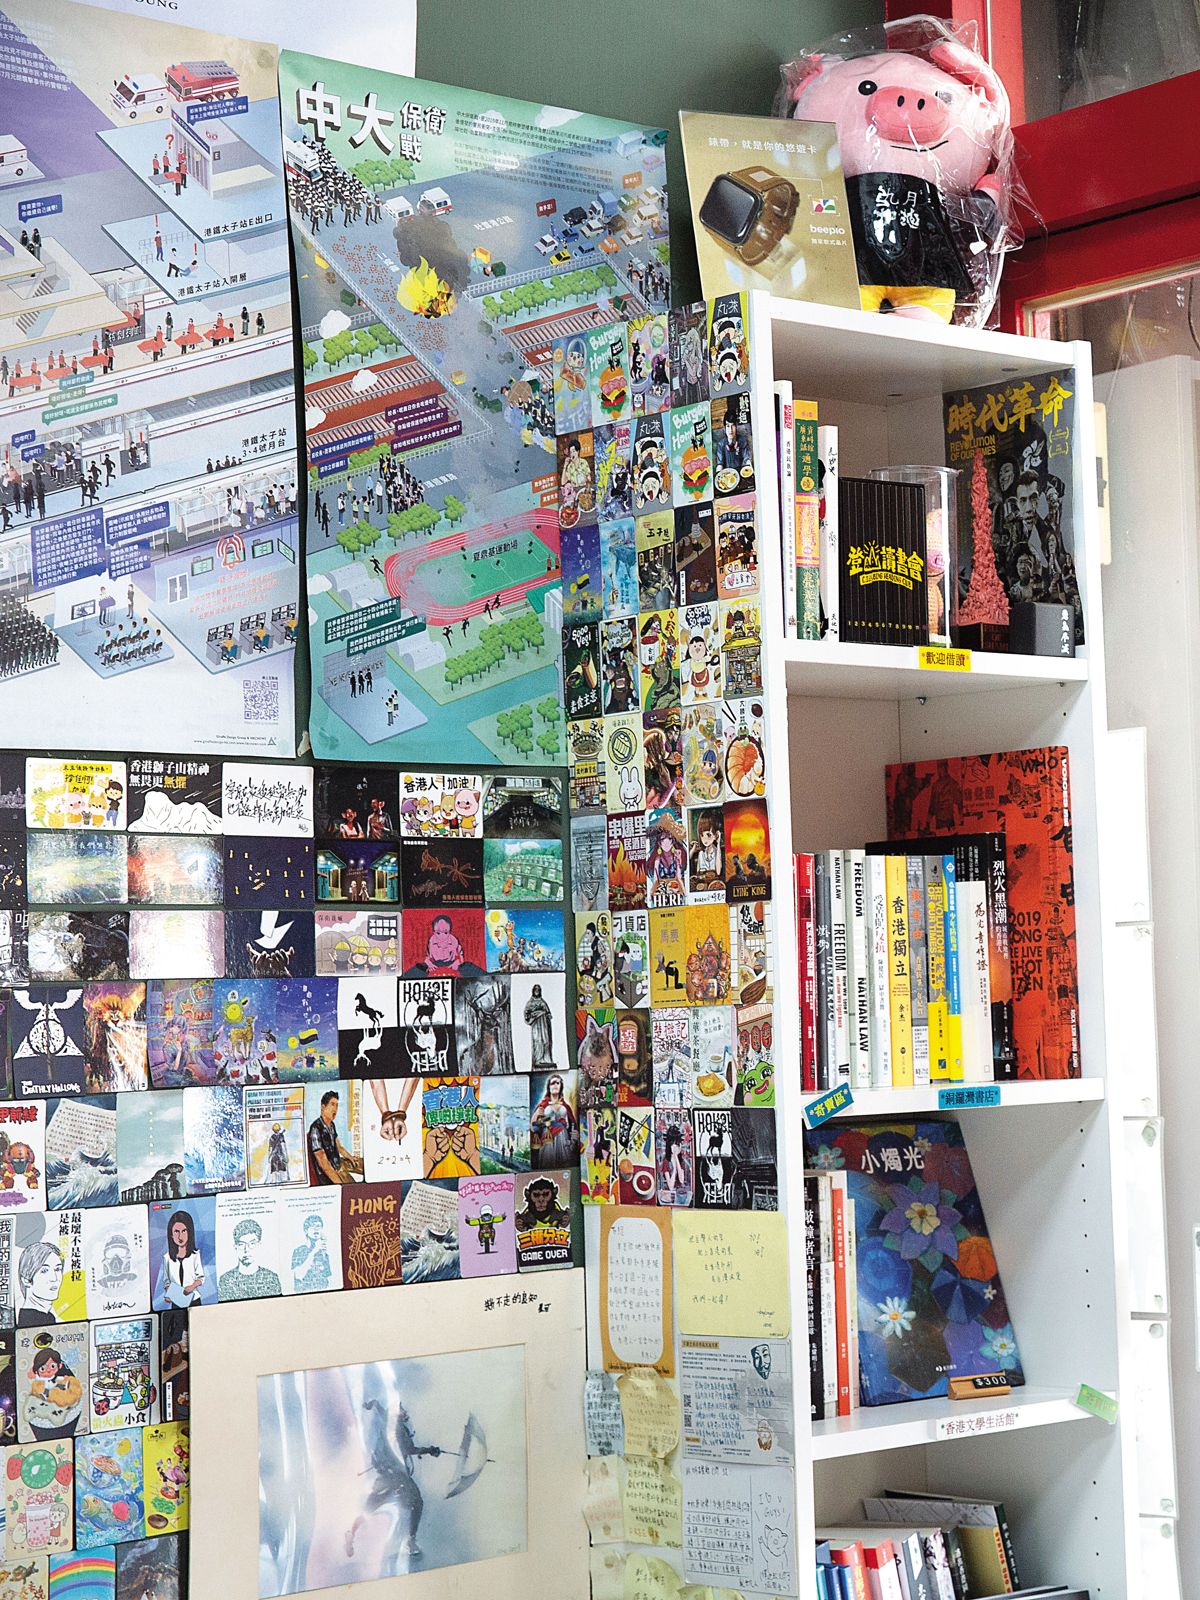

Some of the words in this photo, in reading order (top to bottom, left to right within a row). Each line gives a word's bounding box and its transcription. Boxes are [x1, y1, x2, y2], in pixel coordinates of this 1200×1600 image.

[296, 80, 395, 156] 中大
[399, 101, 447, 136] 保衛
[399, 132, 424, 163] 戰
[204, 213, 273, 236] 港鐵太子站E出口
[947, 377, 1073, 441] 時代革命
[242, 428, 287, 448] 港鐵太子站
[950, 434, 996, 451] REVOLUTION
[925, 652, 966, 667] 歡迎借讀
[130, 760, 210, 776] 香港獅子山精神
[129, 774, 188, 790] 無畏更無懼
[834, 857, 842, 884] NATHAN
[733, 887, 749, 898] LYING
[751, 886, 767, 897] KING
[853, 862, 864, 918] FREEDOM
[992, 860, 1007, 926] 烈火黑潮
[935, 886, 943, 954] REVOLUTION
[1010, 911, 1041, 926] 2019
[834, 923, 846, 971] FREEDOM
[891, 895, 908, 978] 香港獨立
[857, 977, 868, 1024] NATHAN
[860, 1028, 869, 1052] LAW
[423, 1085, 480, 1111] 香港人
[861, 1146, 925, 1174] 小燭光
[349, 1195, 397, 1216] HONG
[70, 1212, 82, 1283] 最壞不是被拉
[521, 1251, 545, 1262] GAME
[546, 1249, 568, 1260] OVER
[975, 1375, 1007, 1387] $300
[946, 1413, 1015, 1435] 香港文學生活館
